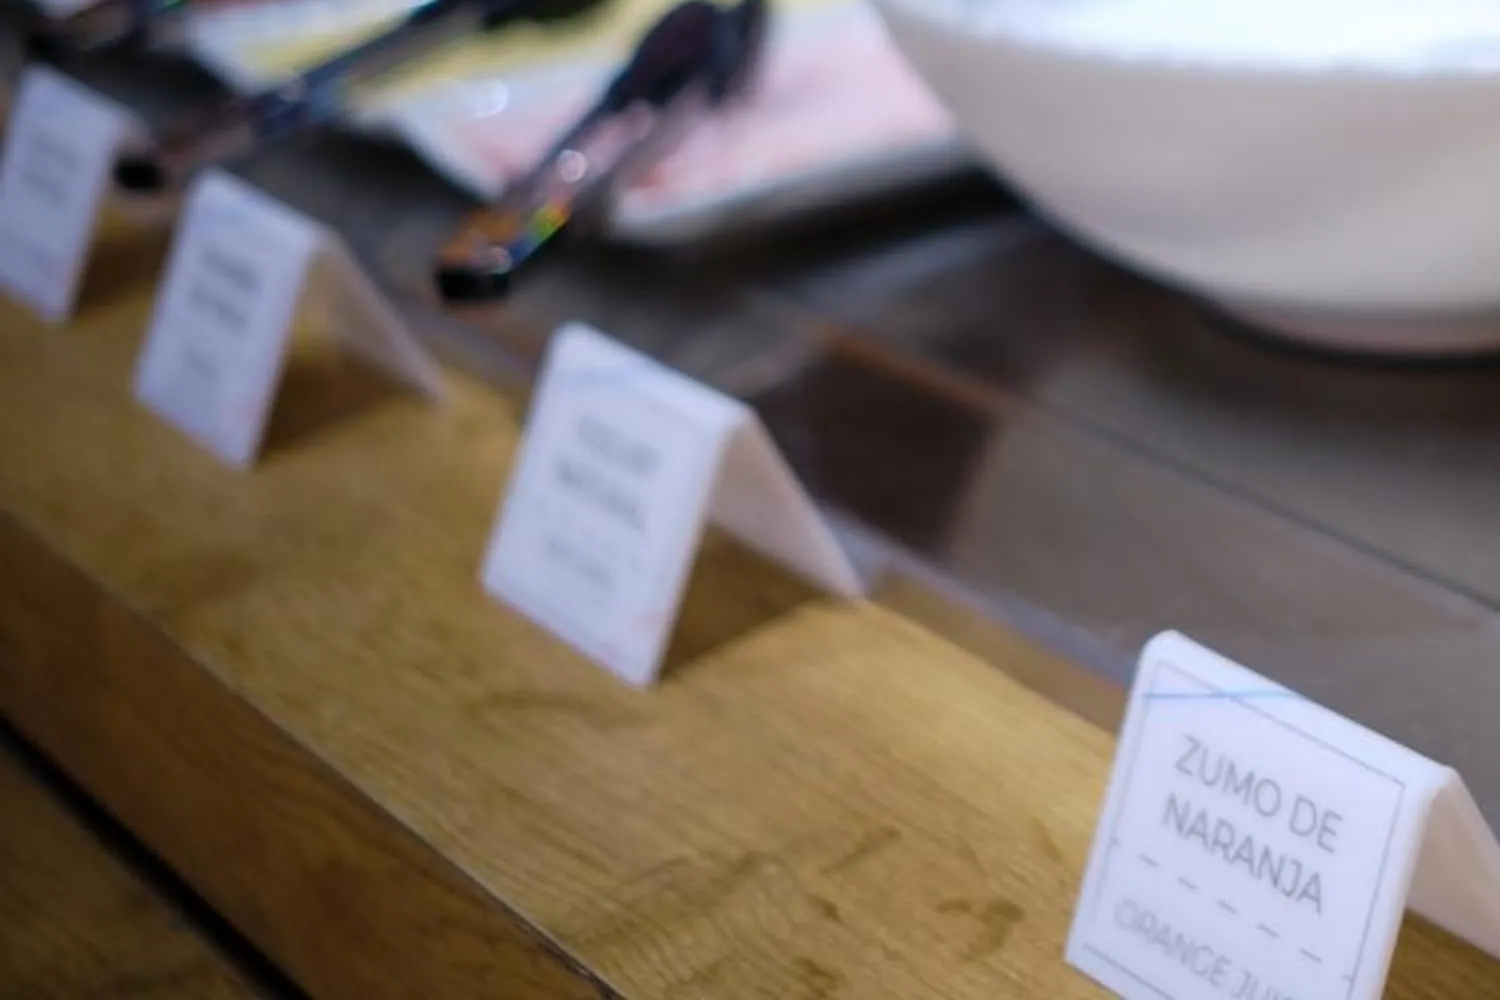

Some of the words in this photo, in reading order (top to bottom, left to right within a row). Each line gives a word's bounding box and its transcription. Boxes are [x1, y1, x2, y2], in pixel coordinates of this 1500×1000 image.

[1162, 793, 1323, 915] NARANJA
[1174, 735, 1283, 819] ZUMO
[1288, 795, 1344, 854] DE
[1113, 897, 1233, 987] ORANGE
